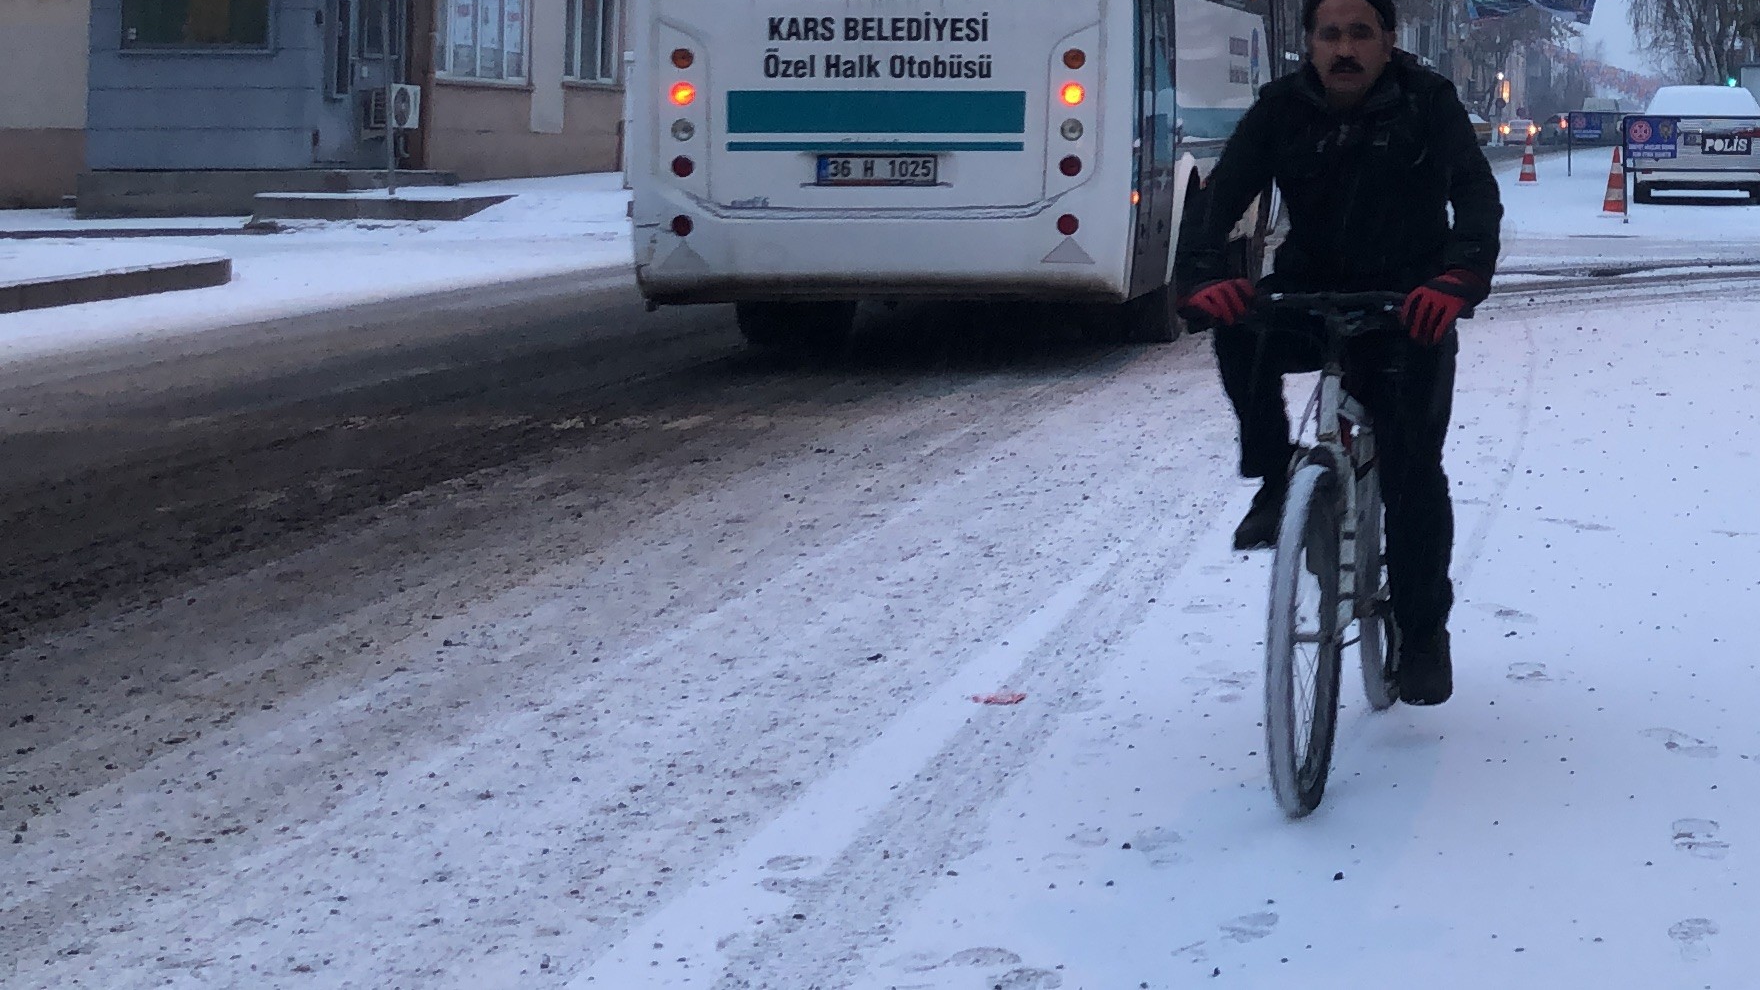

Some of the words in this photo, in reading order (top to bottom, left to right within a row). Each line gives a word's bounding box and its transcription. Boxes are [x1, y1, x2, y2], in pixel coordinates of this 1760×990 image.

[768, 16, 836, 42] KARS
[844, 11, 989, 42] BELEDİYESİ
[764, 48, 816, 78] Özel
[824, 54, 881, 78] Halk
[889, 54, 992, 78] Otobüsü
[1704, 136, 1748, 152] POLİS
[830, 160, 852, 178] 36
[863, 160, 874, 178] H
[888, 160, 932, 178] 1025
